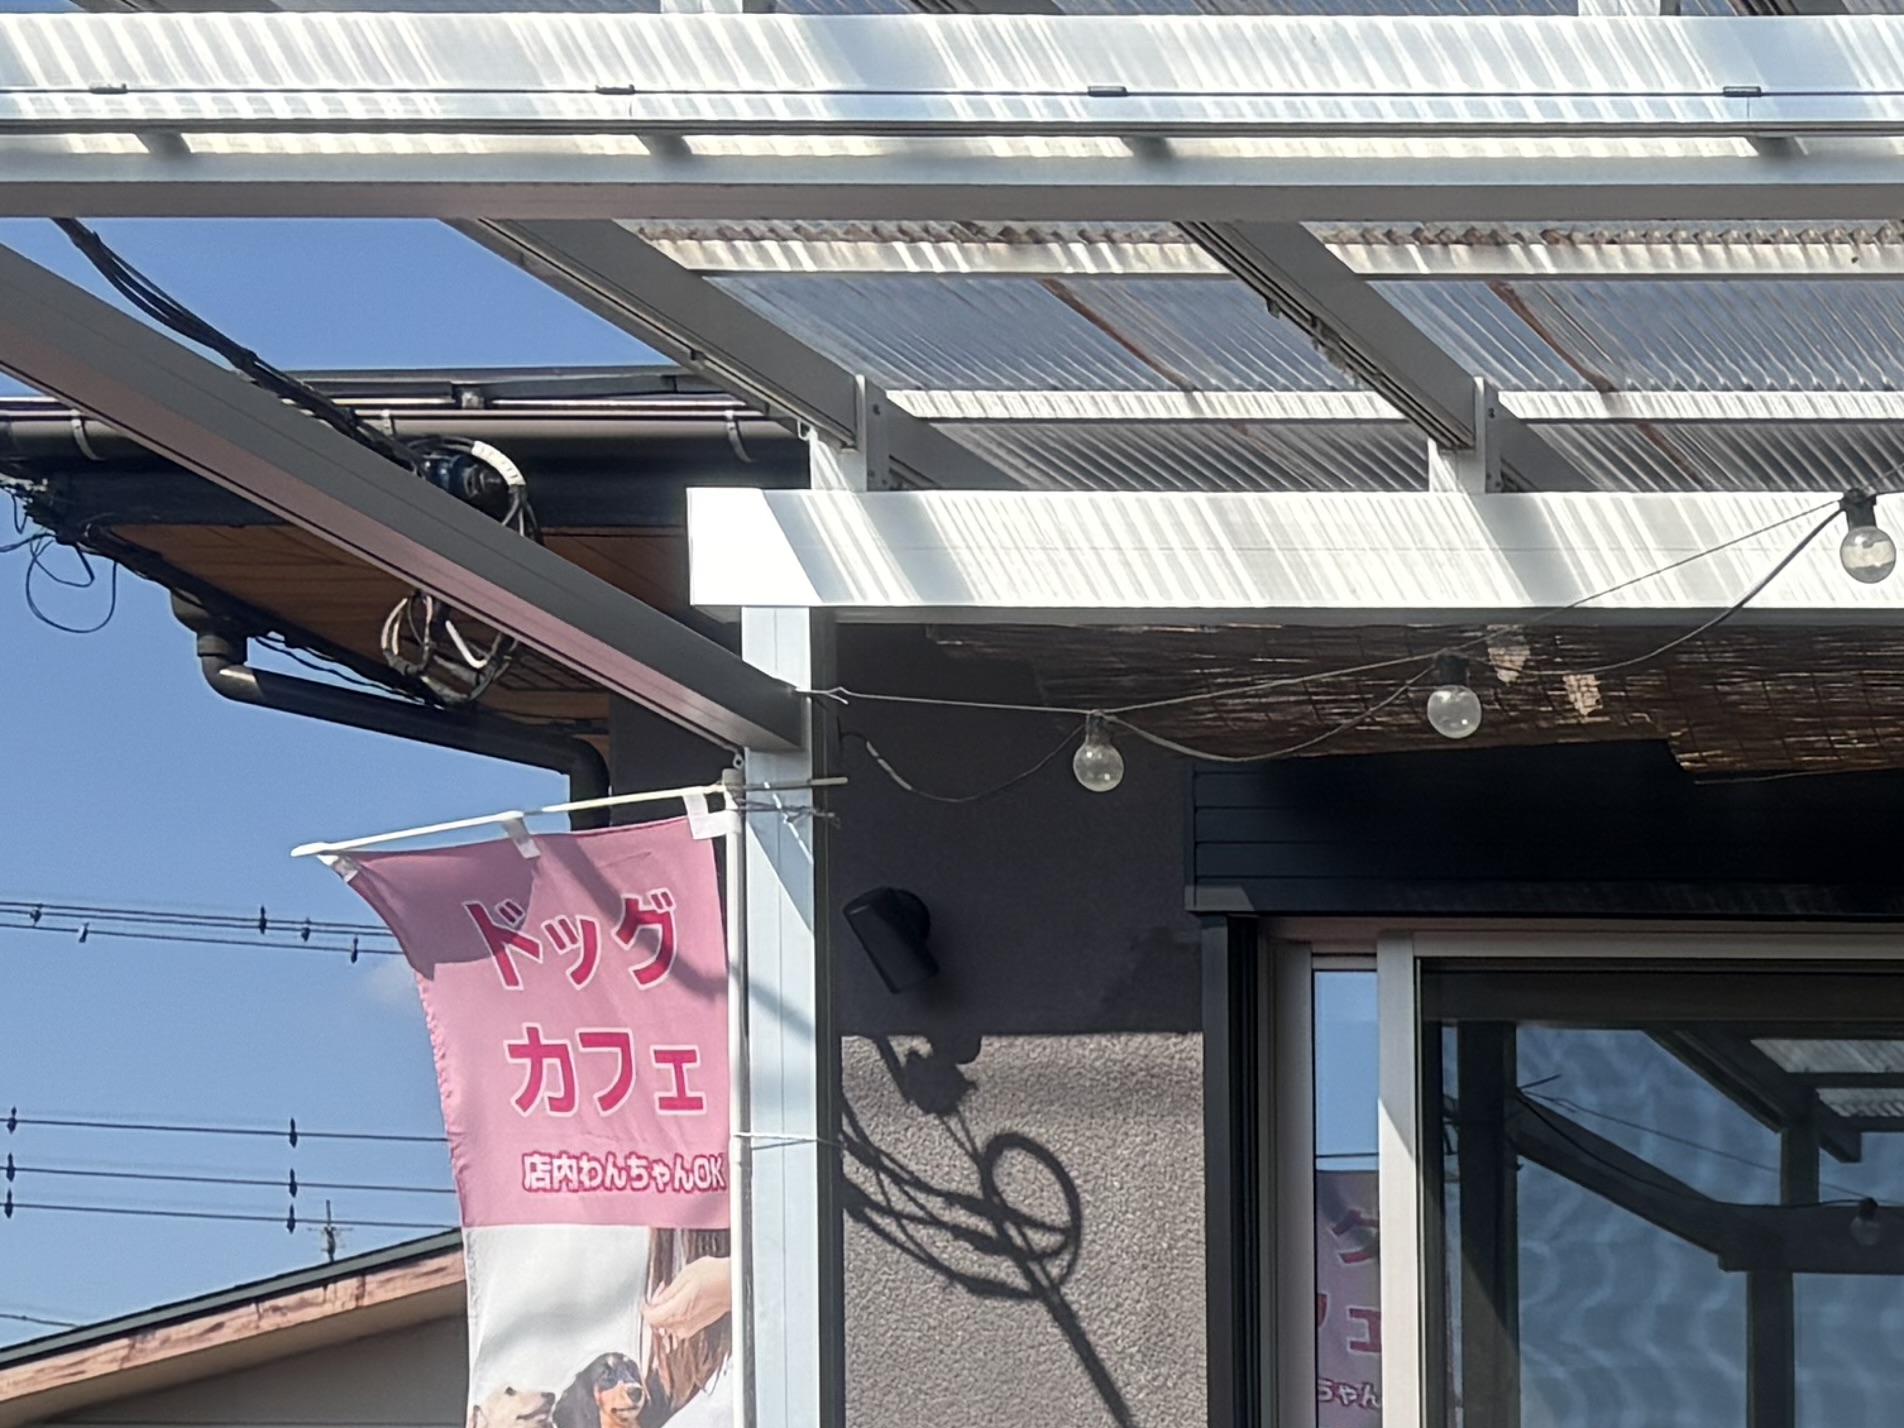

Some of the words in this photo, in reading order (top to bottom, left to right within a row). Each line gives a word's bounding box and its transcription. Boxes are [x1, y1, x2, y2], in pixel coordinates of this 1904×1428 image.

[465, 887, 679, 991] ドッグ
[505, 1023, 707, 1117] カフェ
[522, 1150, 727, 1193] 店内わんちゃんOK
